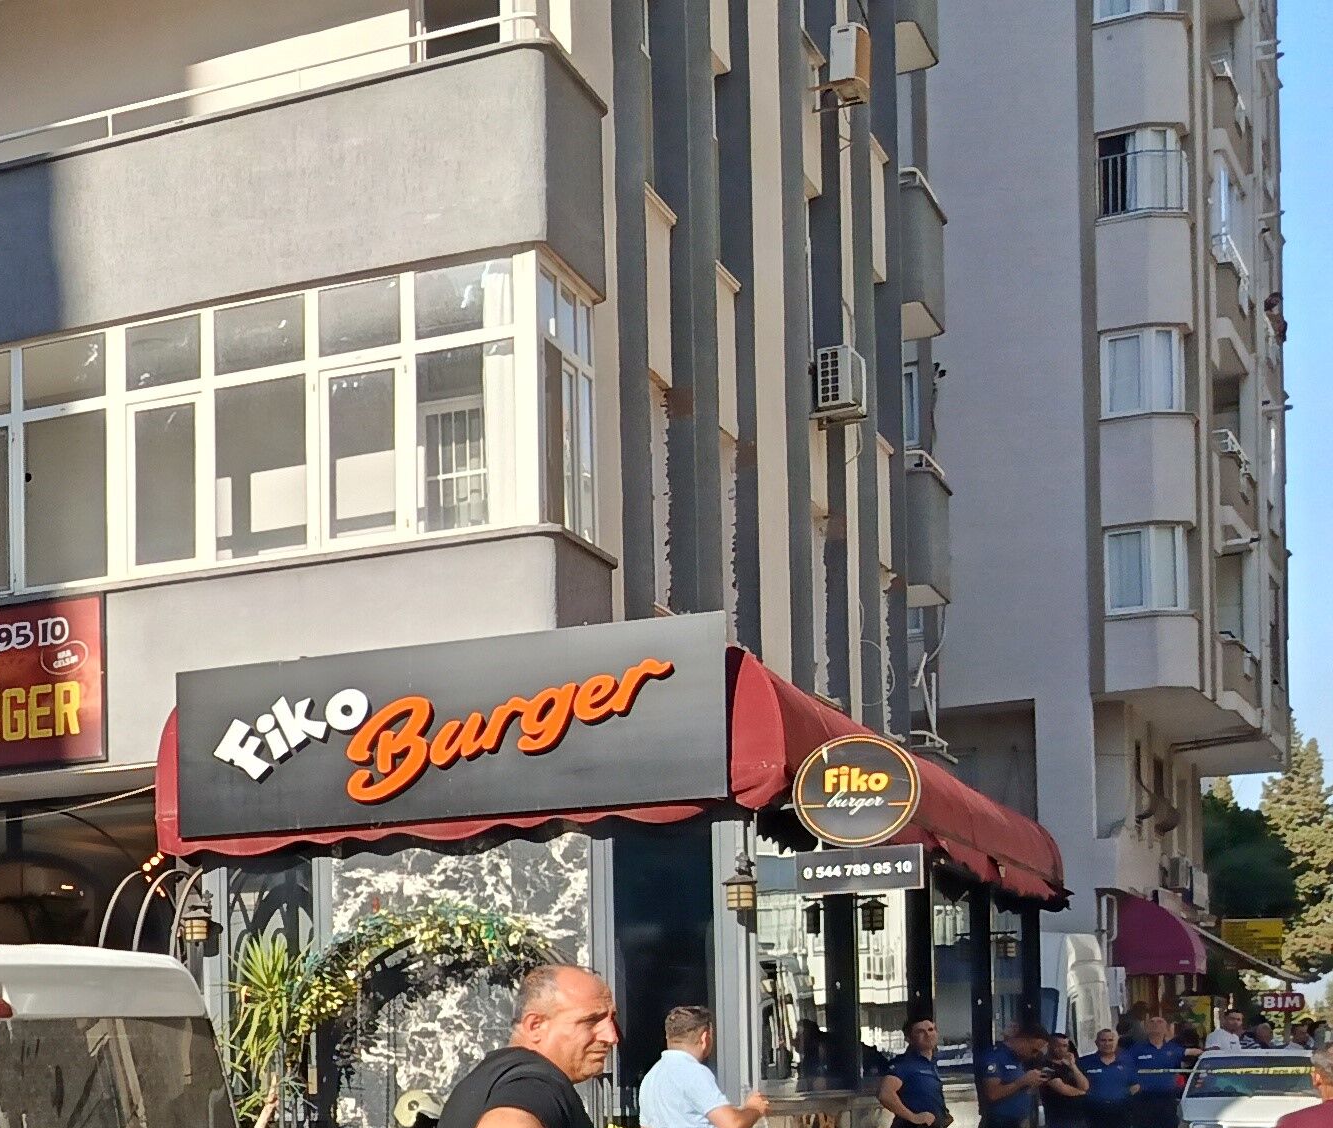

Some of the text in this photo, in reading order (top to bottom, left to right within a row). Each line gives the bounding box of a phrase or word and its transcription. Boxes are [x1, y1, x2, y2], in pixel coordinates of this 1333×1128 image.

[38, 617, 70, 646] 10
[213, 657, 674, 802] Fiko Burger
[823, 765, 889, 793] Fiko
[826, 790, 884, 816] burger
[803, 860, 913, 879] 0 544 789 95 10
